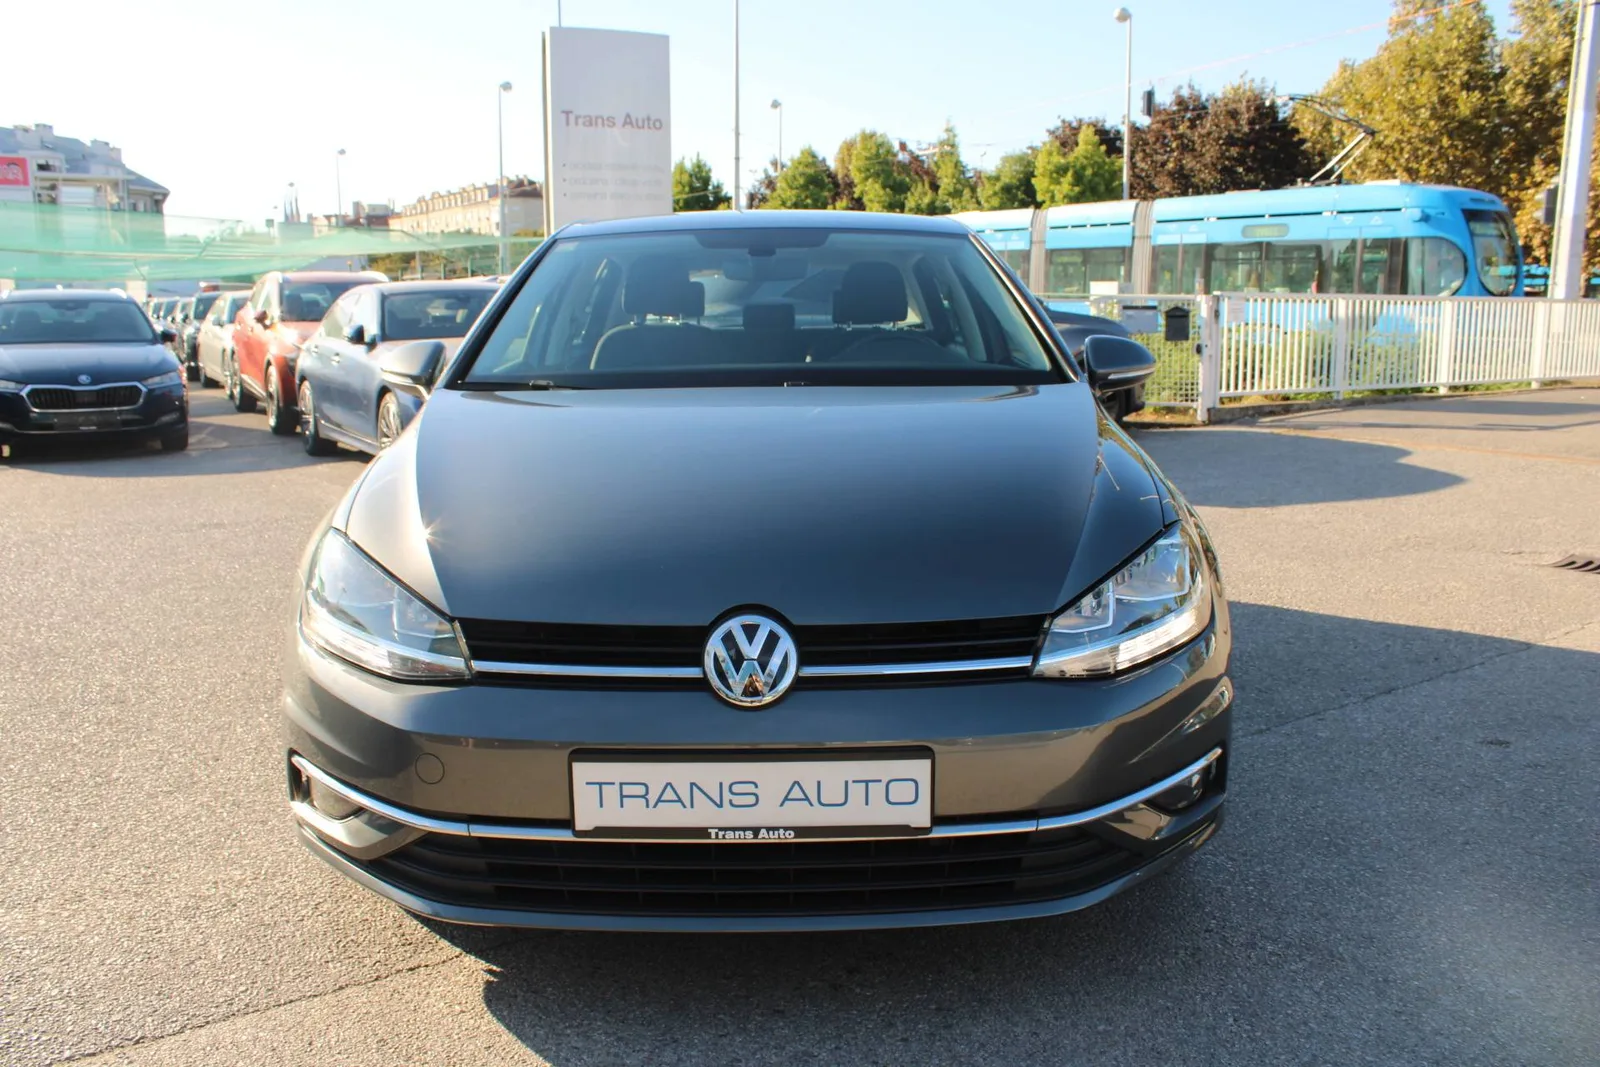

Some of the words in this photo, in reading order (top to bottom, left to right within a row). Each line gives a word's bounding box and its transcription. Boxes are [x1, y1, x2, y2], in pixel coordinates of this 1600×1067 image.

[561, 110, 616, 128] Trans
[622, 112, 663, 130] Auto
[585, 780, 760, 809] TRANS
[779, 777, 919, 807] AUTO
[707, 828, 754, 839] Trans
[758, 828, 795, 839] Auto
